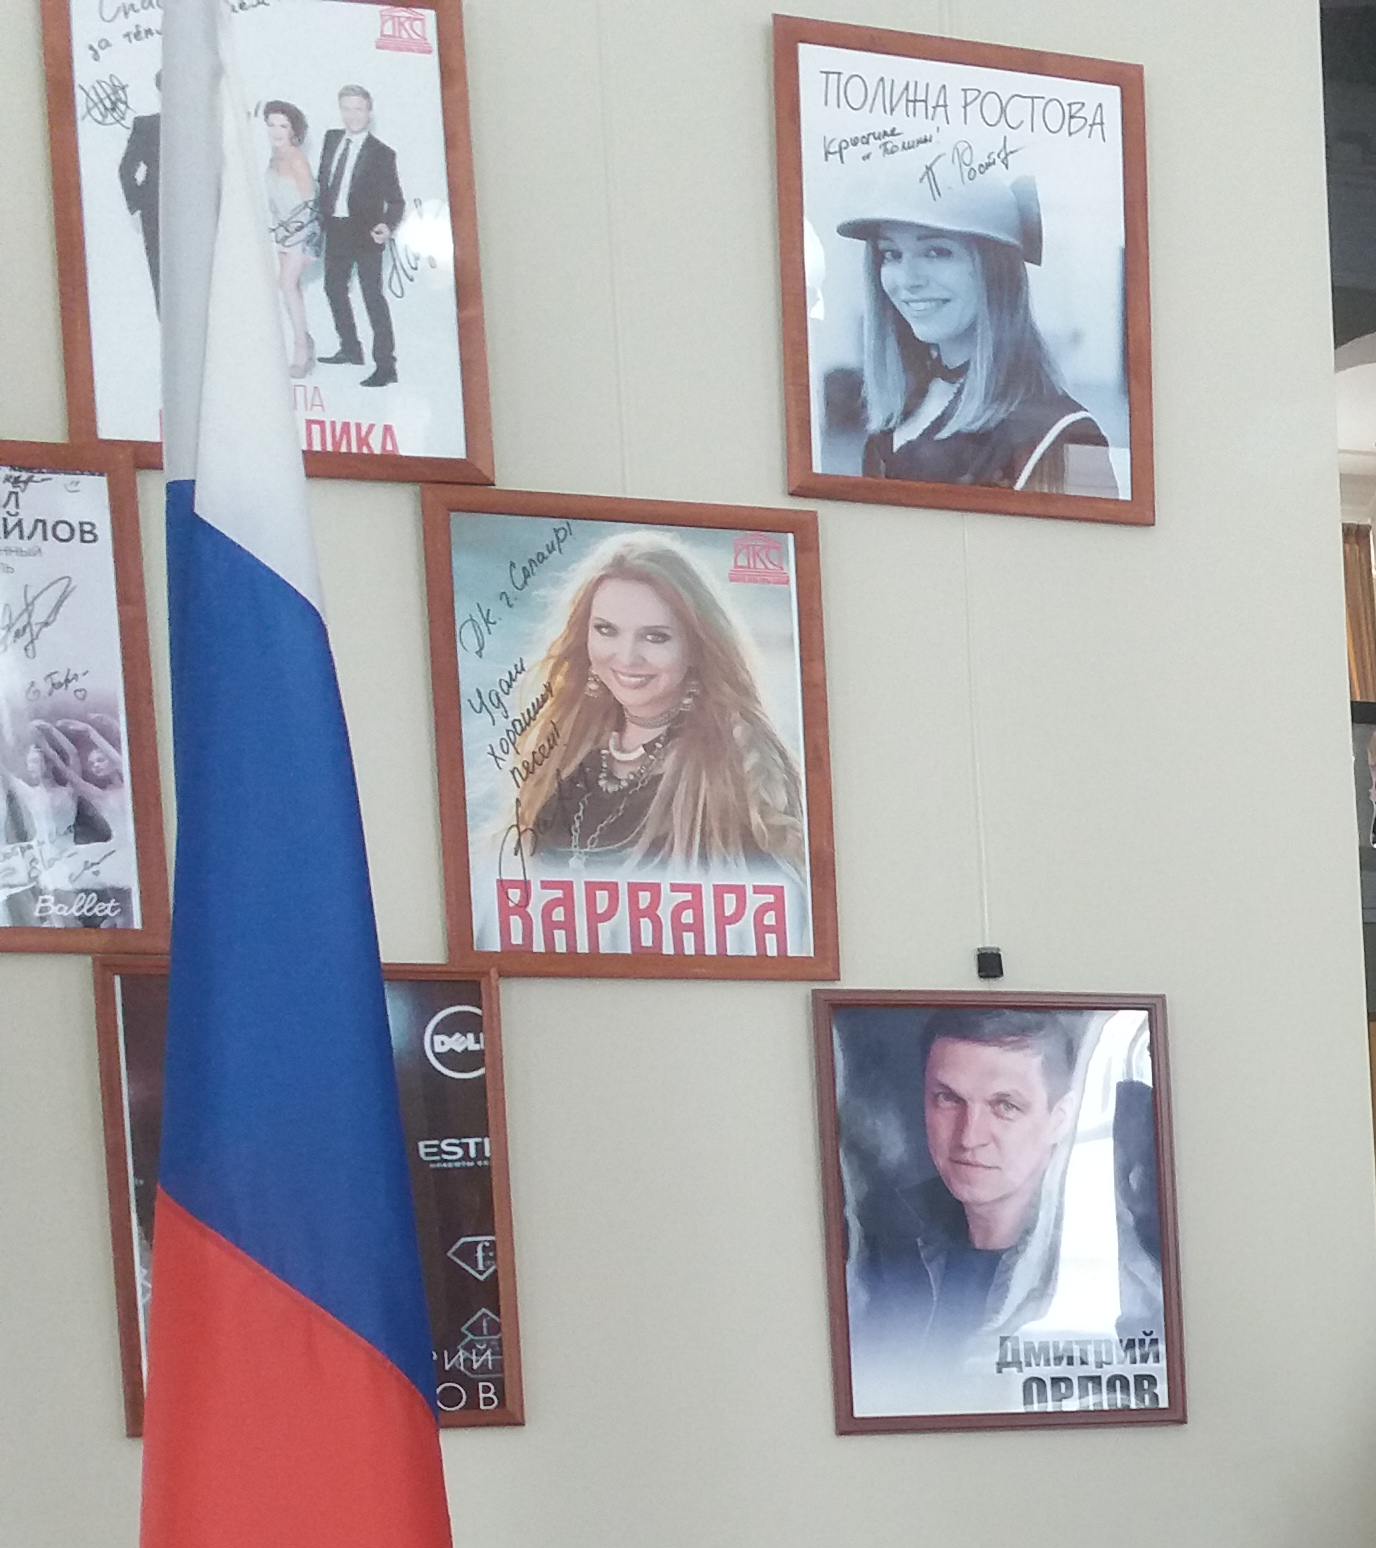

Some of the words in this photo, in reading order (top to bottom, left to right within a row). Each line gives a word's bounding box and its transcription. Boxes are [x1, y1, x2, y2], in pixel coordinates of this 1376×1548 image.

[819, 70, 950, 125] ПОЛИНА
[961, 87, 1108, 142] РОСТОВА
[34, 892, 122, 917] Ballet
[496, 878, 788, 956] ВАРВАРА
